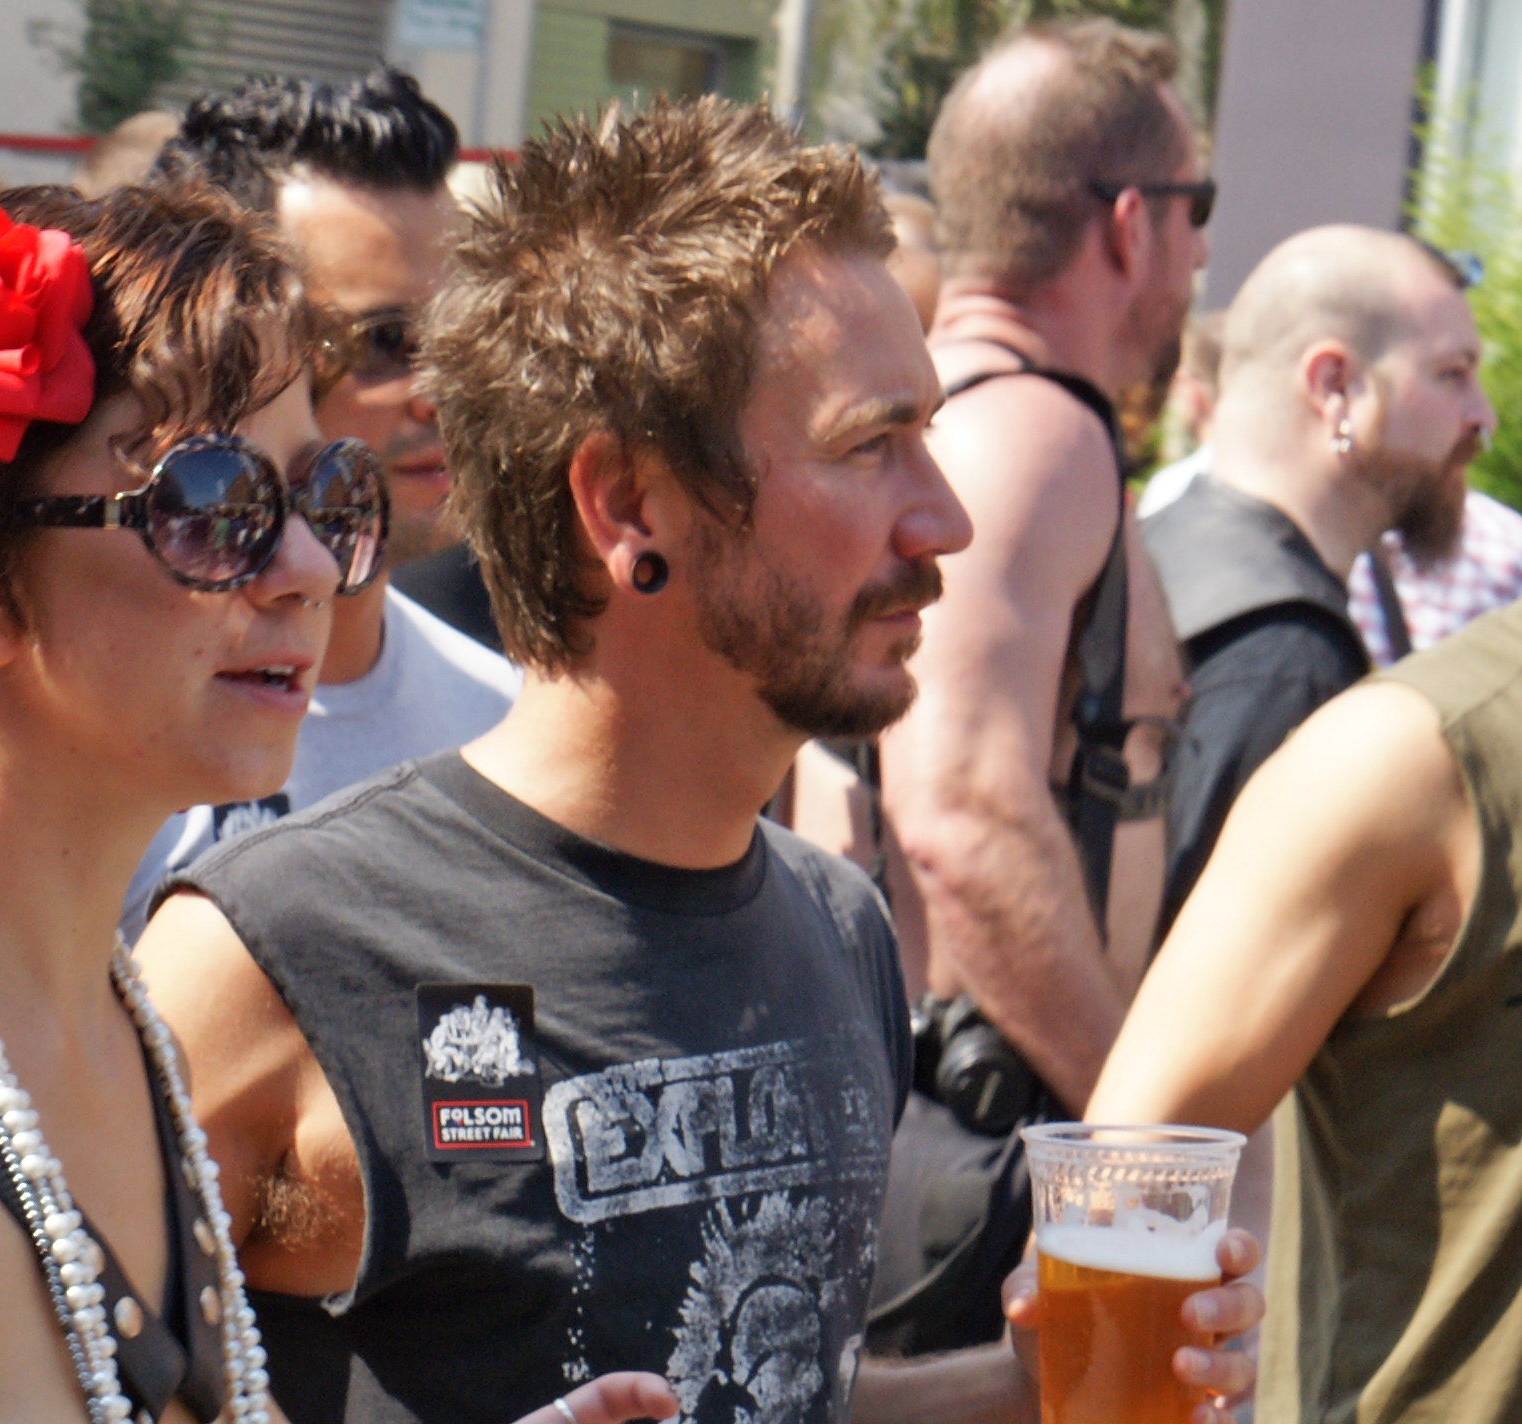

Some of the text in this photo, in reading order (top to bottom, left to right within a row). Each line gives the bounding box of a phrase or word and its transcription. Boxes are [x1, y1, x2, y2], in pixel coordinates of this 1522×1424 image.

[439, 1106, 522, 1127] FOLSOM
[441, 1126, 524, 1142] STREET FAIR
